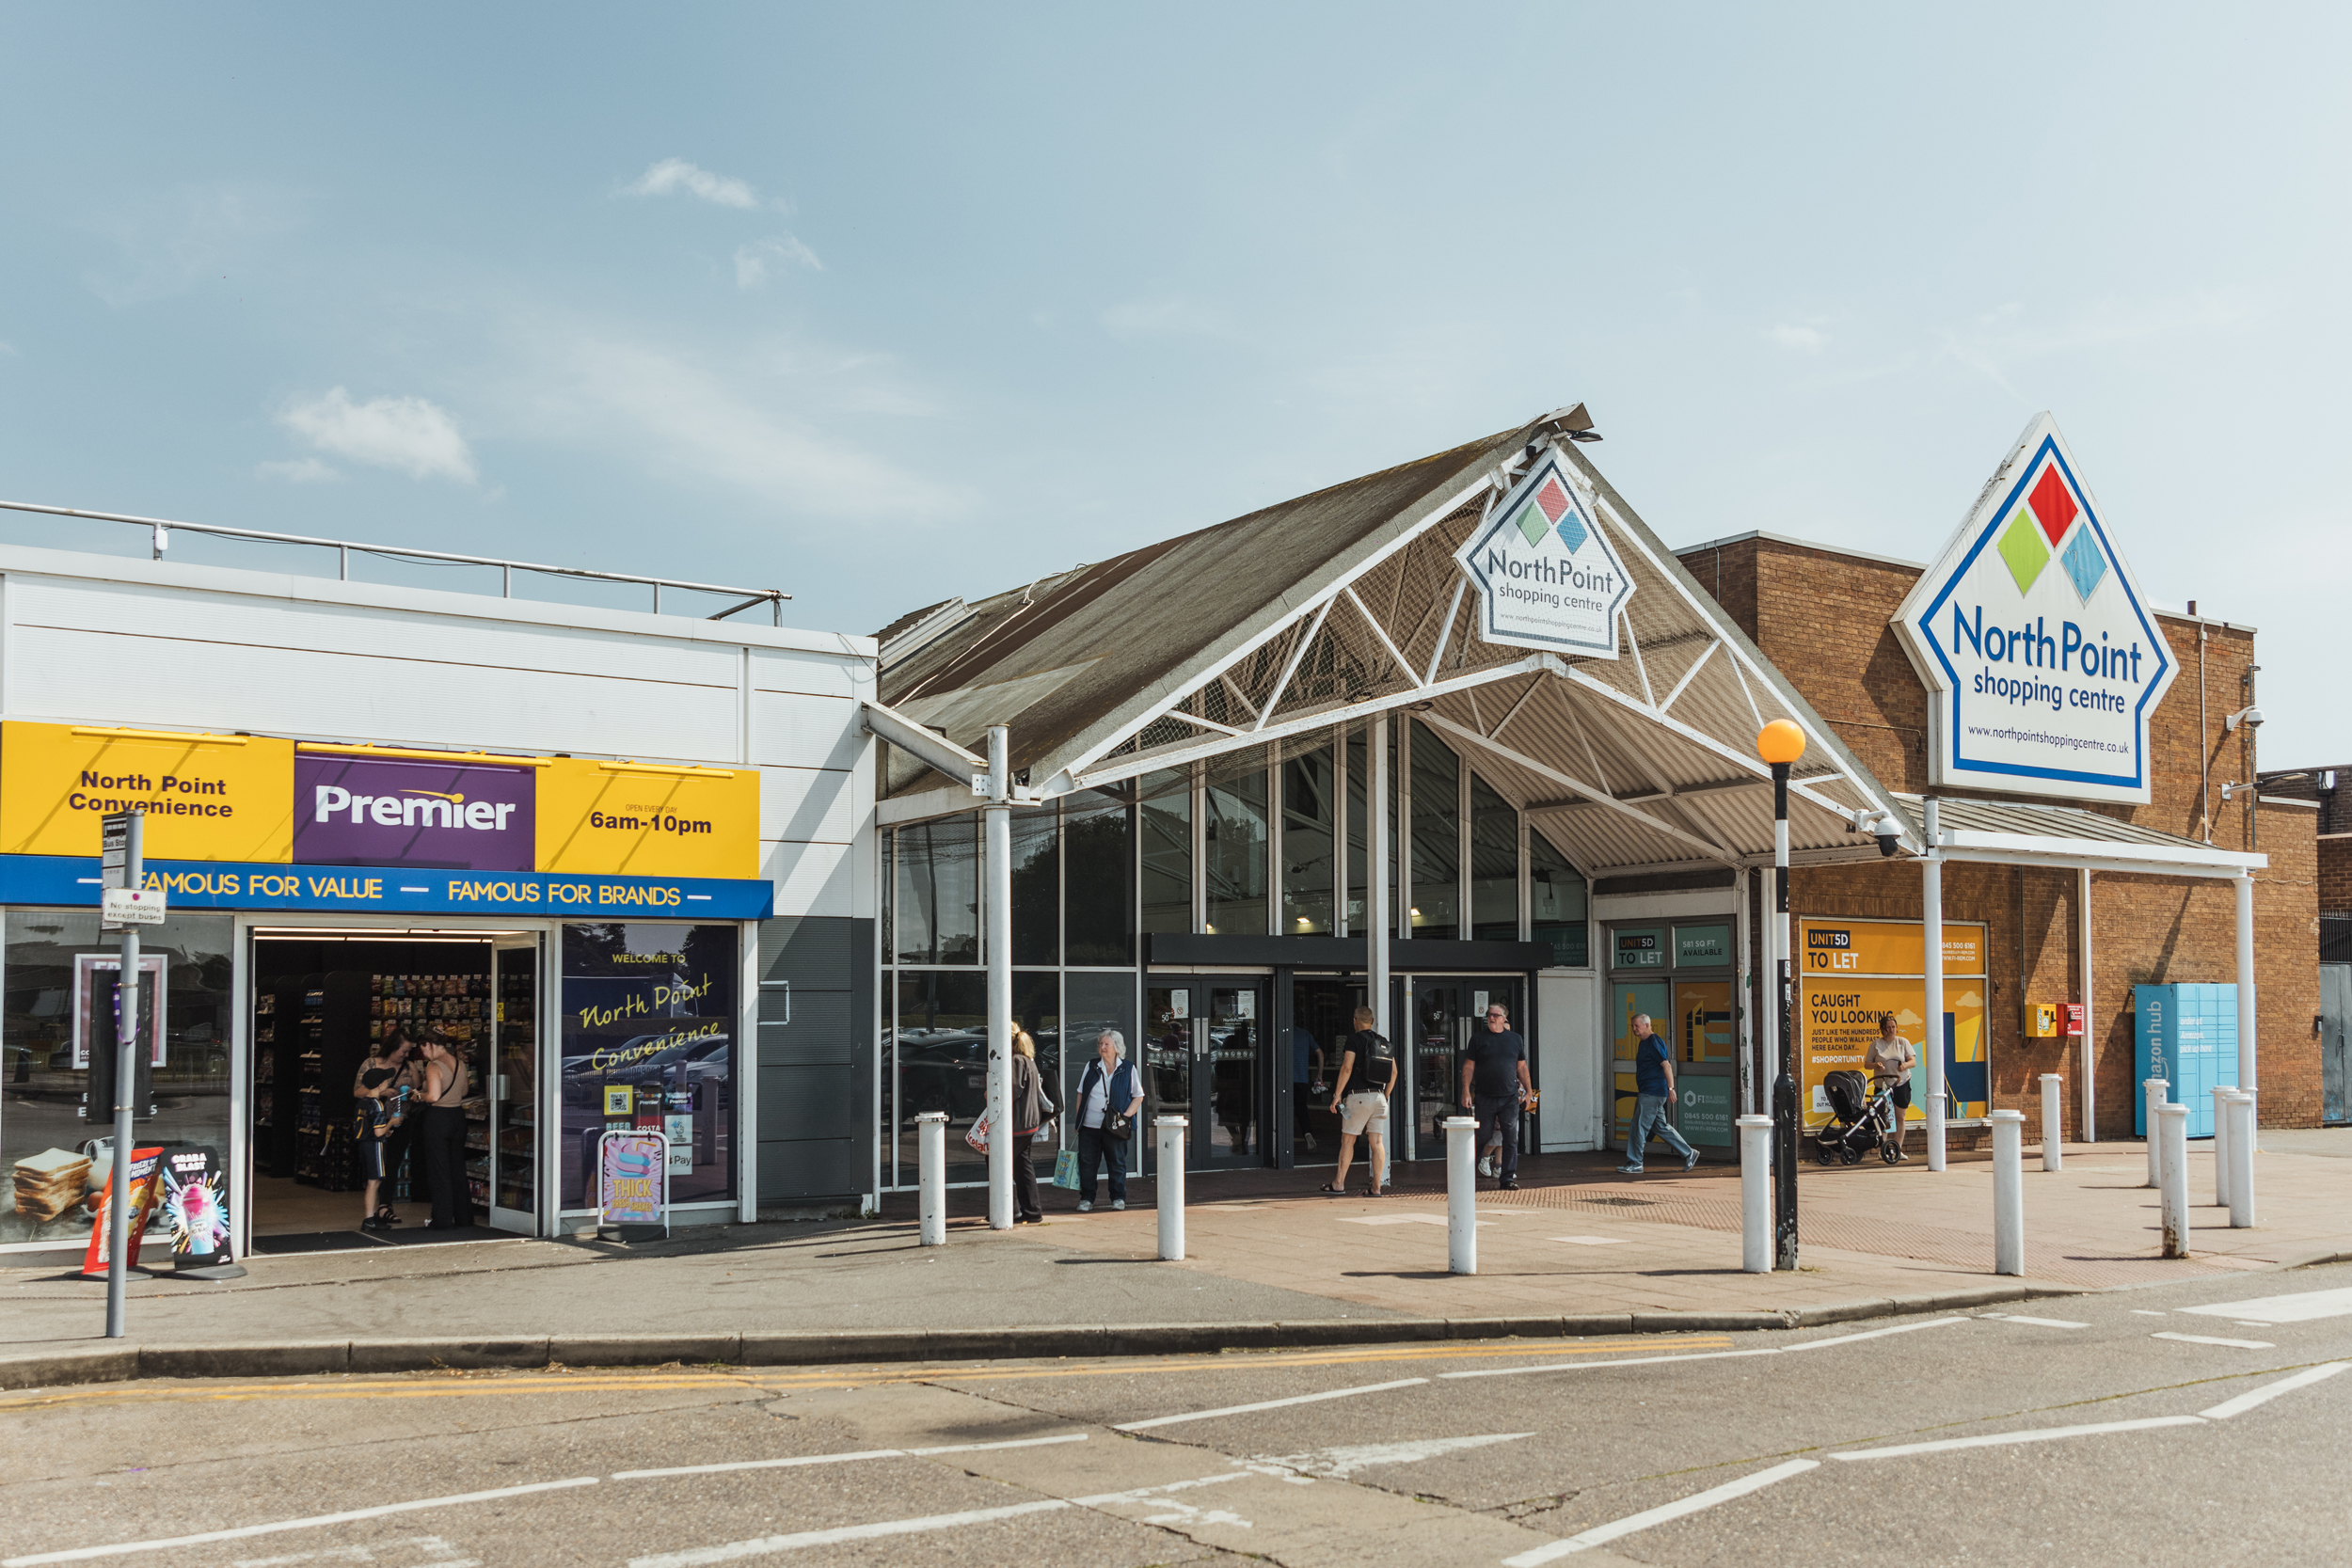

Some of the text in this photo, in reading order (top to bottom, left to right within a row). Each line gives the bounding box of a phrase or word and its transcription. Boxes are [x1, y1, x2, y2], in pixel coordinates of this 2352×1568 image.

[1499, 582, 1603, 612] shopping centre
[1500, 612, 1603, 634] www.northpointshoppingcentre.co.uk
[1974, 665, 2125, 714] shopping centre
[1967, 725, 2129, 753] www.northpointshoppingcentre.co.uk
[81, 770, 227, 796] North Point
[69, 793, 233, 817] Convenience
[314, 784, 516, 832] Premier
[625, 803, 678, 815] OPEN EVERY DAY
[590, 811, 712, 836] 6am-10pm
[249, 875, 300, 896] FOR
[309, 877, 384, 899] VALUE
[448, 880, 681, 907] FAMOUS FOR BRANDS
[125, 903, 161, 913] stopping
[107, 911, 135, 921] except
[1695, 940, 1706, 948] SQ
[612, 954, 686, 964] WELCOME TO
[1619, 951, 1662, 964] TO LET
[1683, 948, 1723, 957] AVAILABLE
[1808, 952, 1859, 969] TO LET
[579, 973, 712, 1029] North Point
[1811, 994, 1861, 1007] CAUGHT
[1812, 1010, 1837, 1023] YOU
[2147, 1001, 2162, 1034] hub
[2180, 1017, 2196, 1025] order
[592, 1022, 720, 1071] Convenience
[2180, 1045, 2191, 1053] pick
[1812, 1054, 1865, 1064] #SHOPORTUNITY
[2151, 1037, 2162, 1079] azon
[605, 1122, 631, 1131] BEER
[130, 1160, 150, 1172] FREEZE
[674, 1155, 691, 1165] Pay
[130, 1165, 156, 1178] MOMENT
[175, 1162, 206, 1172] BLAST
[612, 1180, 653, 1197] THICK
[612, 1198, 653, 1212] FRESH SHAKES
